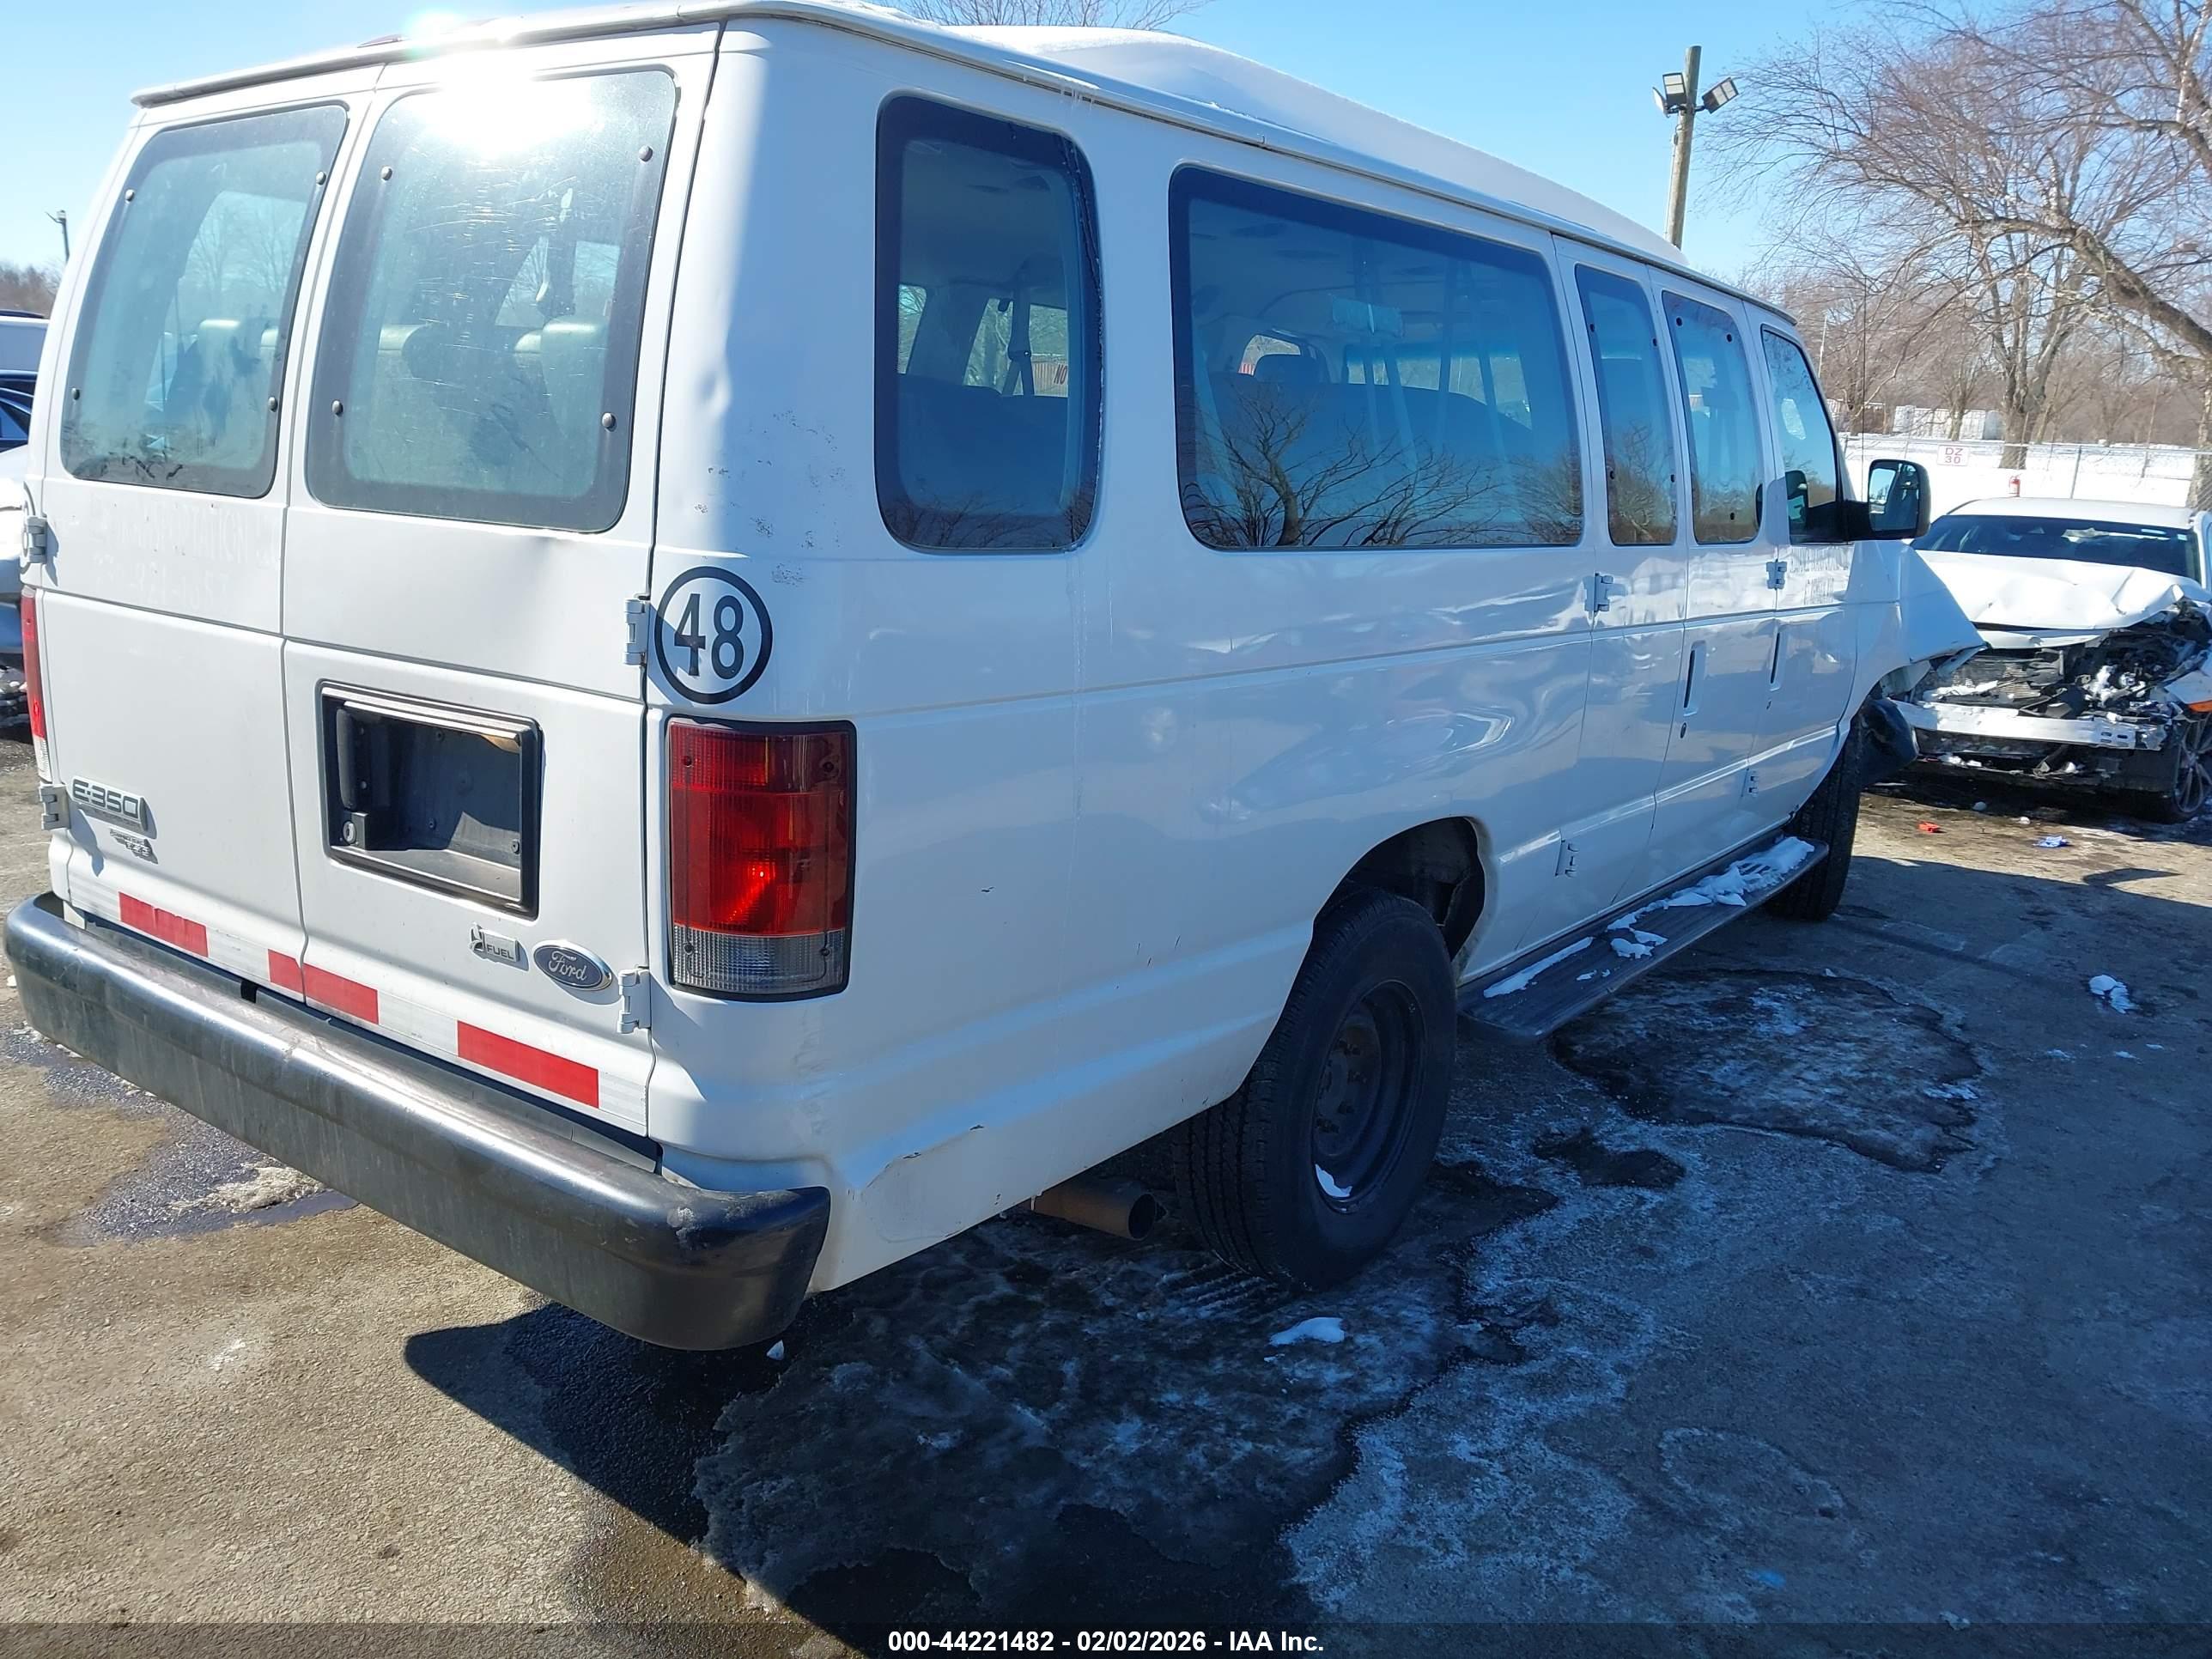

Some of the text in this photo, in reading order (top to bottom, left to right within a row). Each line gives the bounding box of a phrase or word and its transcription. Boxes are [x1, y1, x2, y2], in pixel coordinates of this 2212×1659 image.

[674, 592, 744, 680] 48
[486, 944, 514, 960] FUEL
[548, 951, 588, 981] Ford
